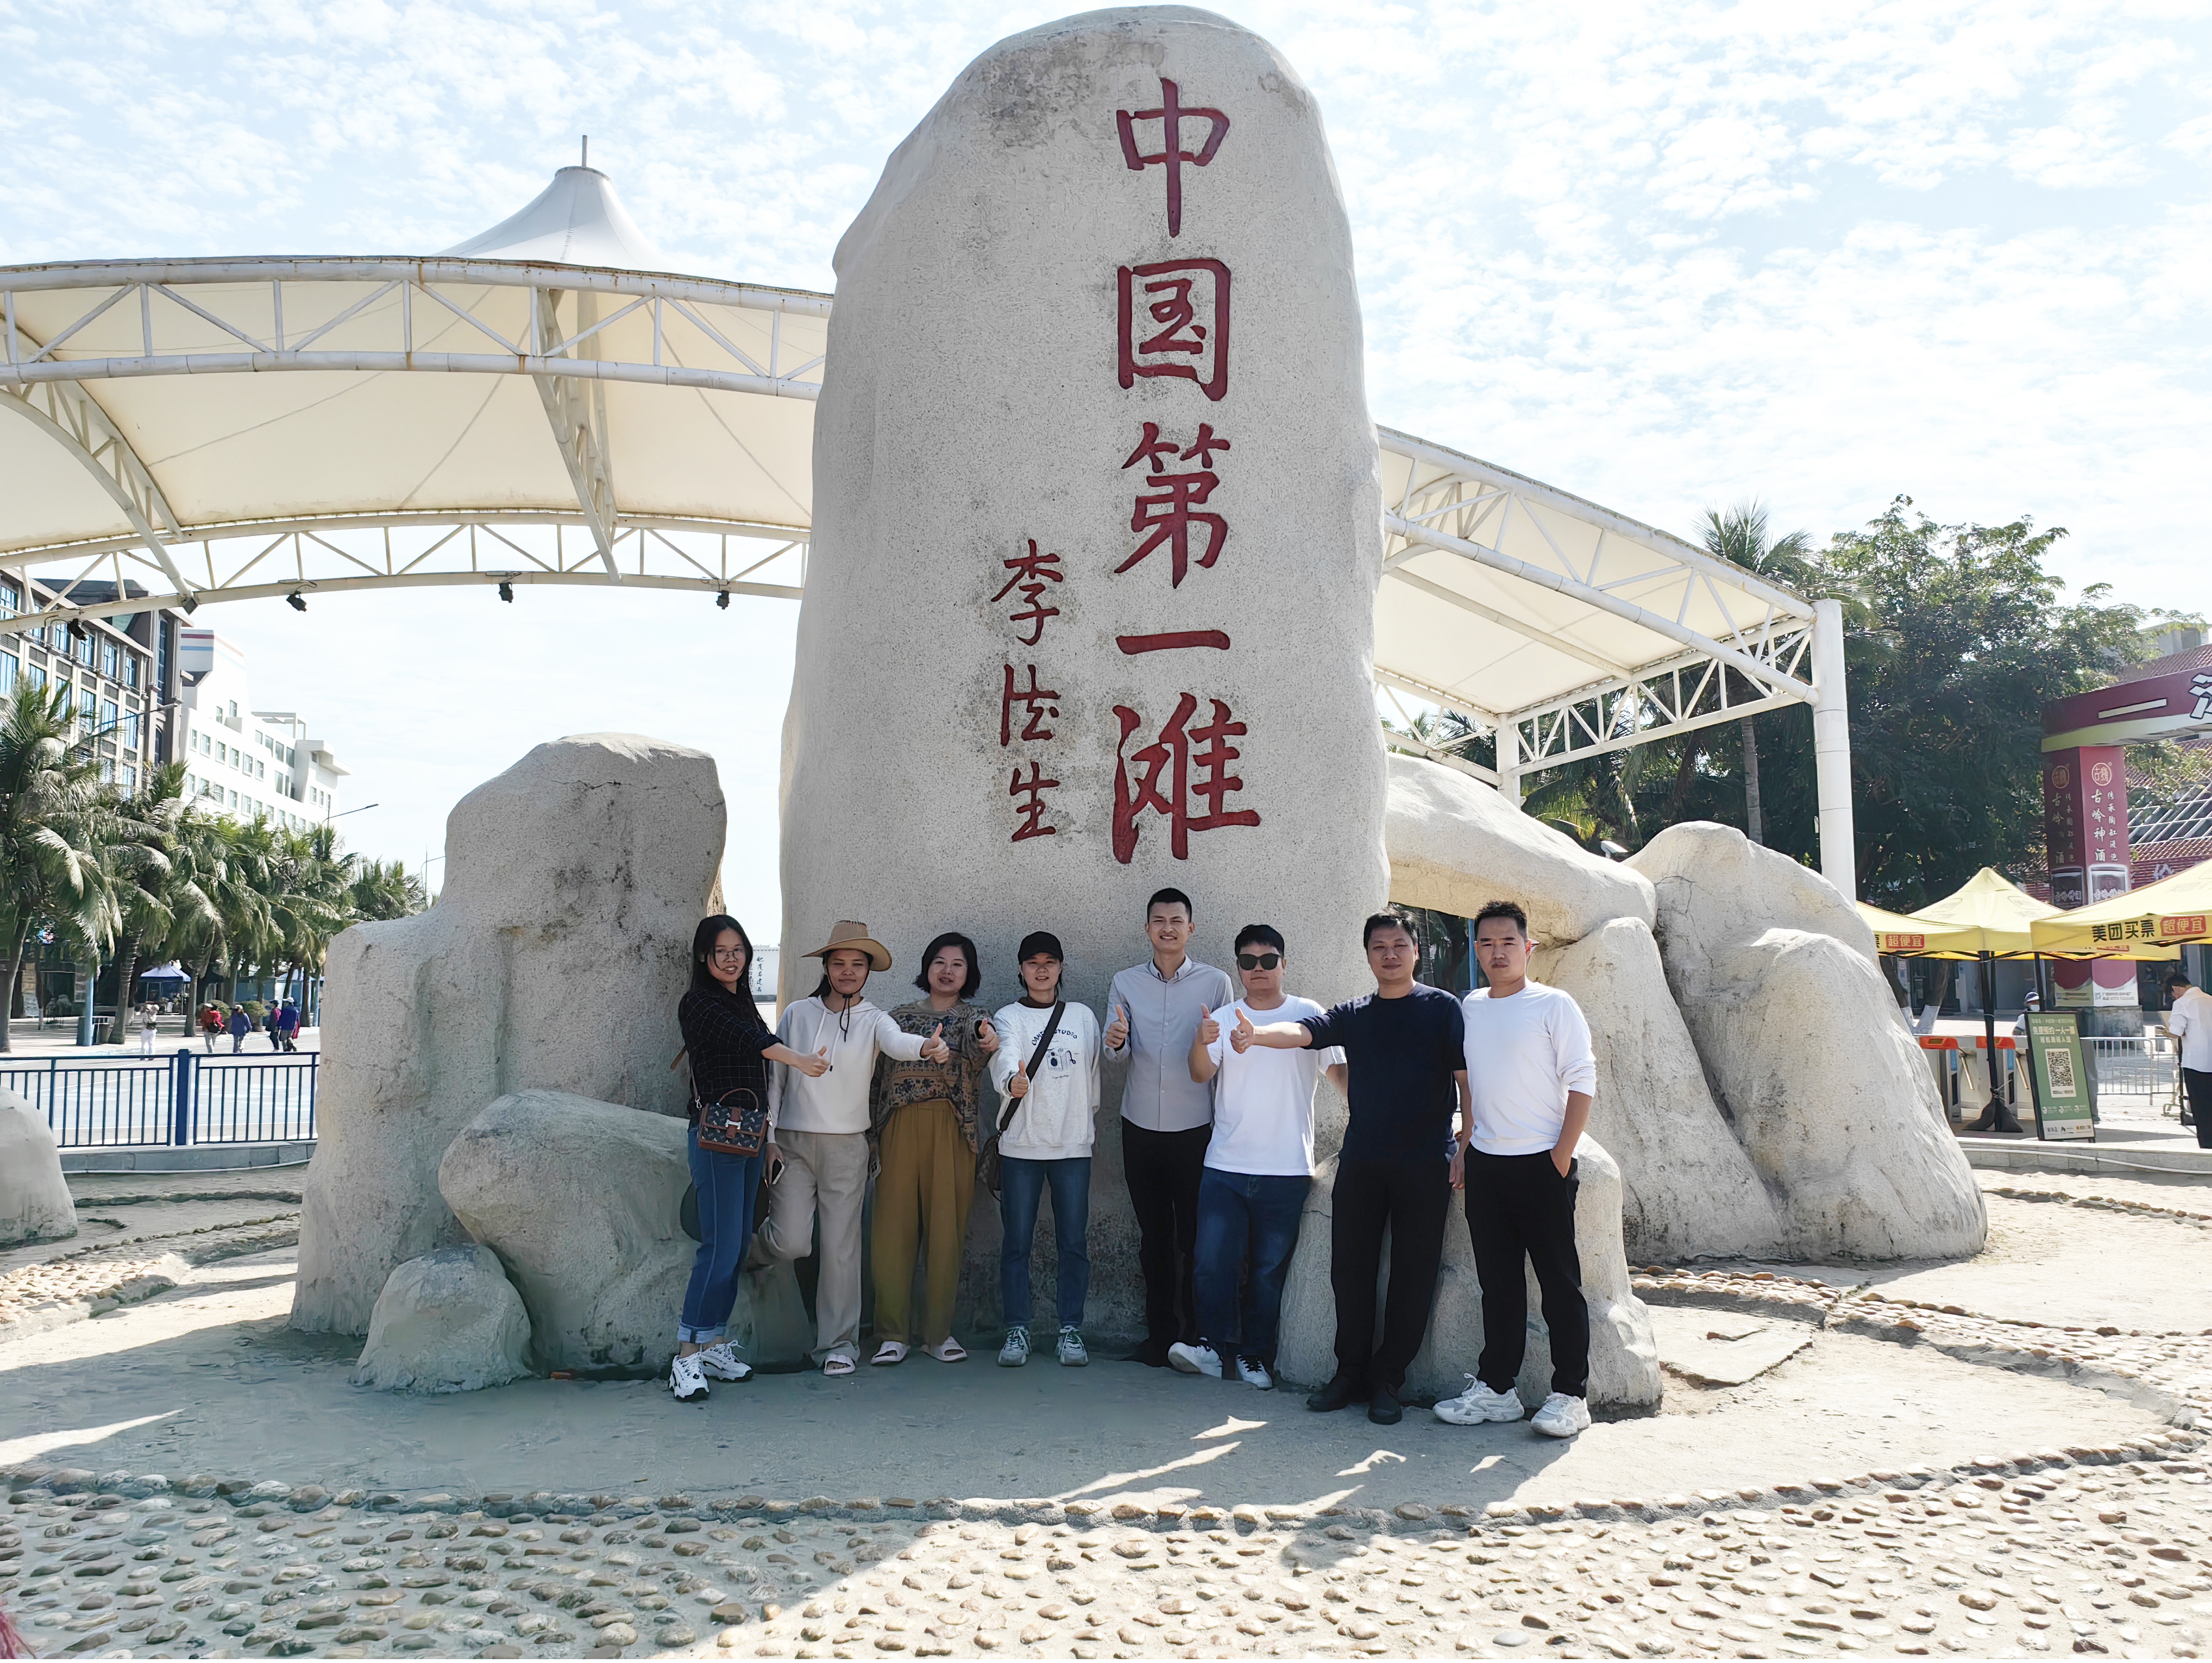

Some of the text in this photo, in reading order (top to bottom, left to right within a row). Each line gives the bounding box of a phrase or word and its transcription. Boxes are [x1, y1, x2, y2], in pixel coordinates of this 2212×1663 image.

[1113, 76, 1261, 864] 中国第一滩
[2052, 792, 2064, 864] 古岭酒
[2091, 788, 2106, 862] 古岭神酒
[1887, 935, 1923, 947] 超便宜
[2091, 919, 2155, 942] 美团买票
[2163, 917, 2203, 934] 超便宜
